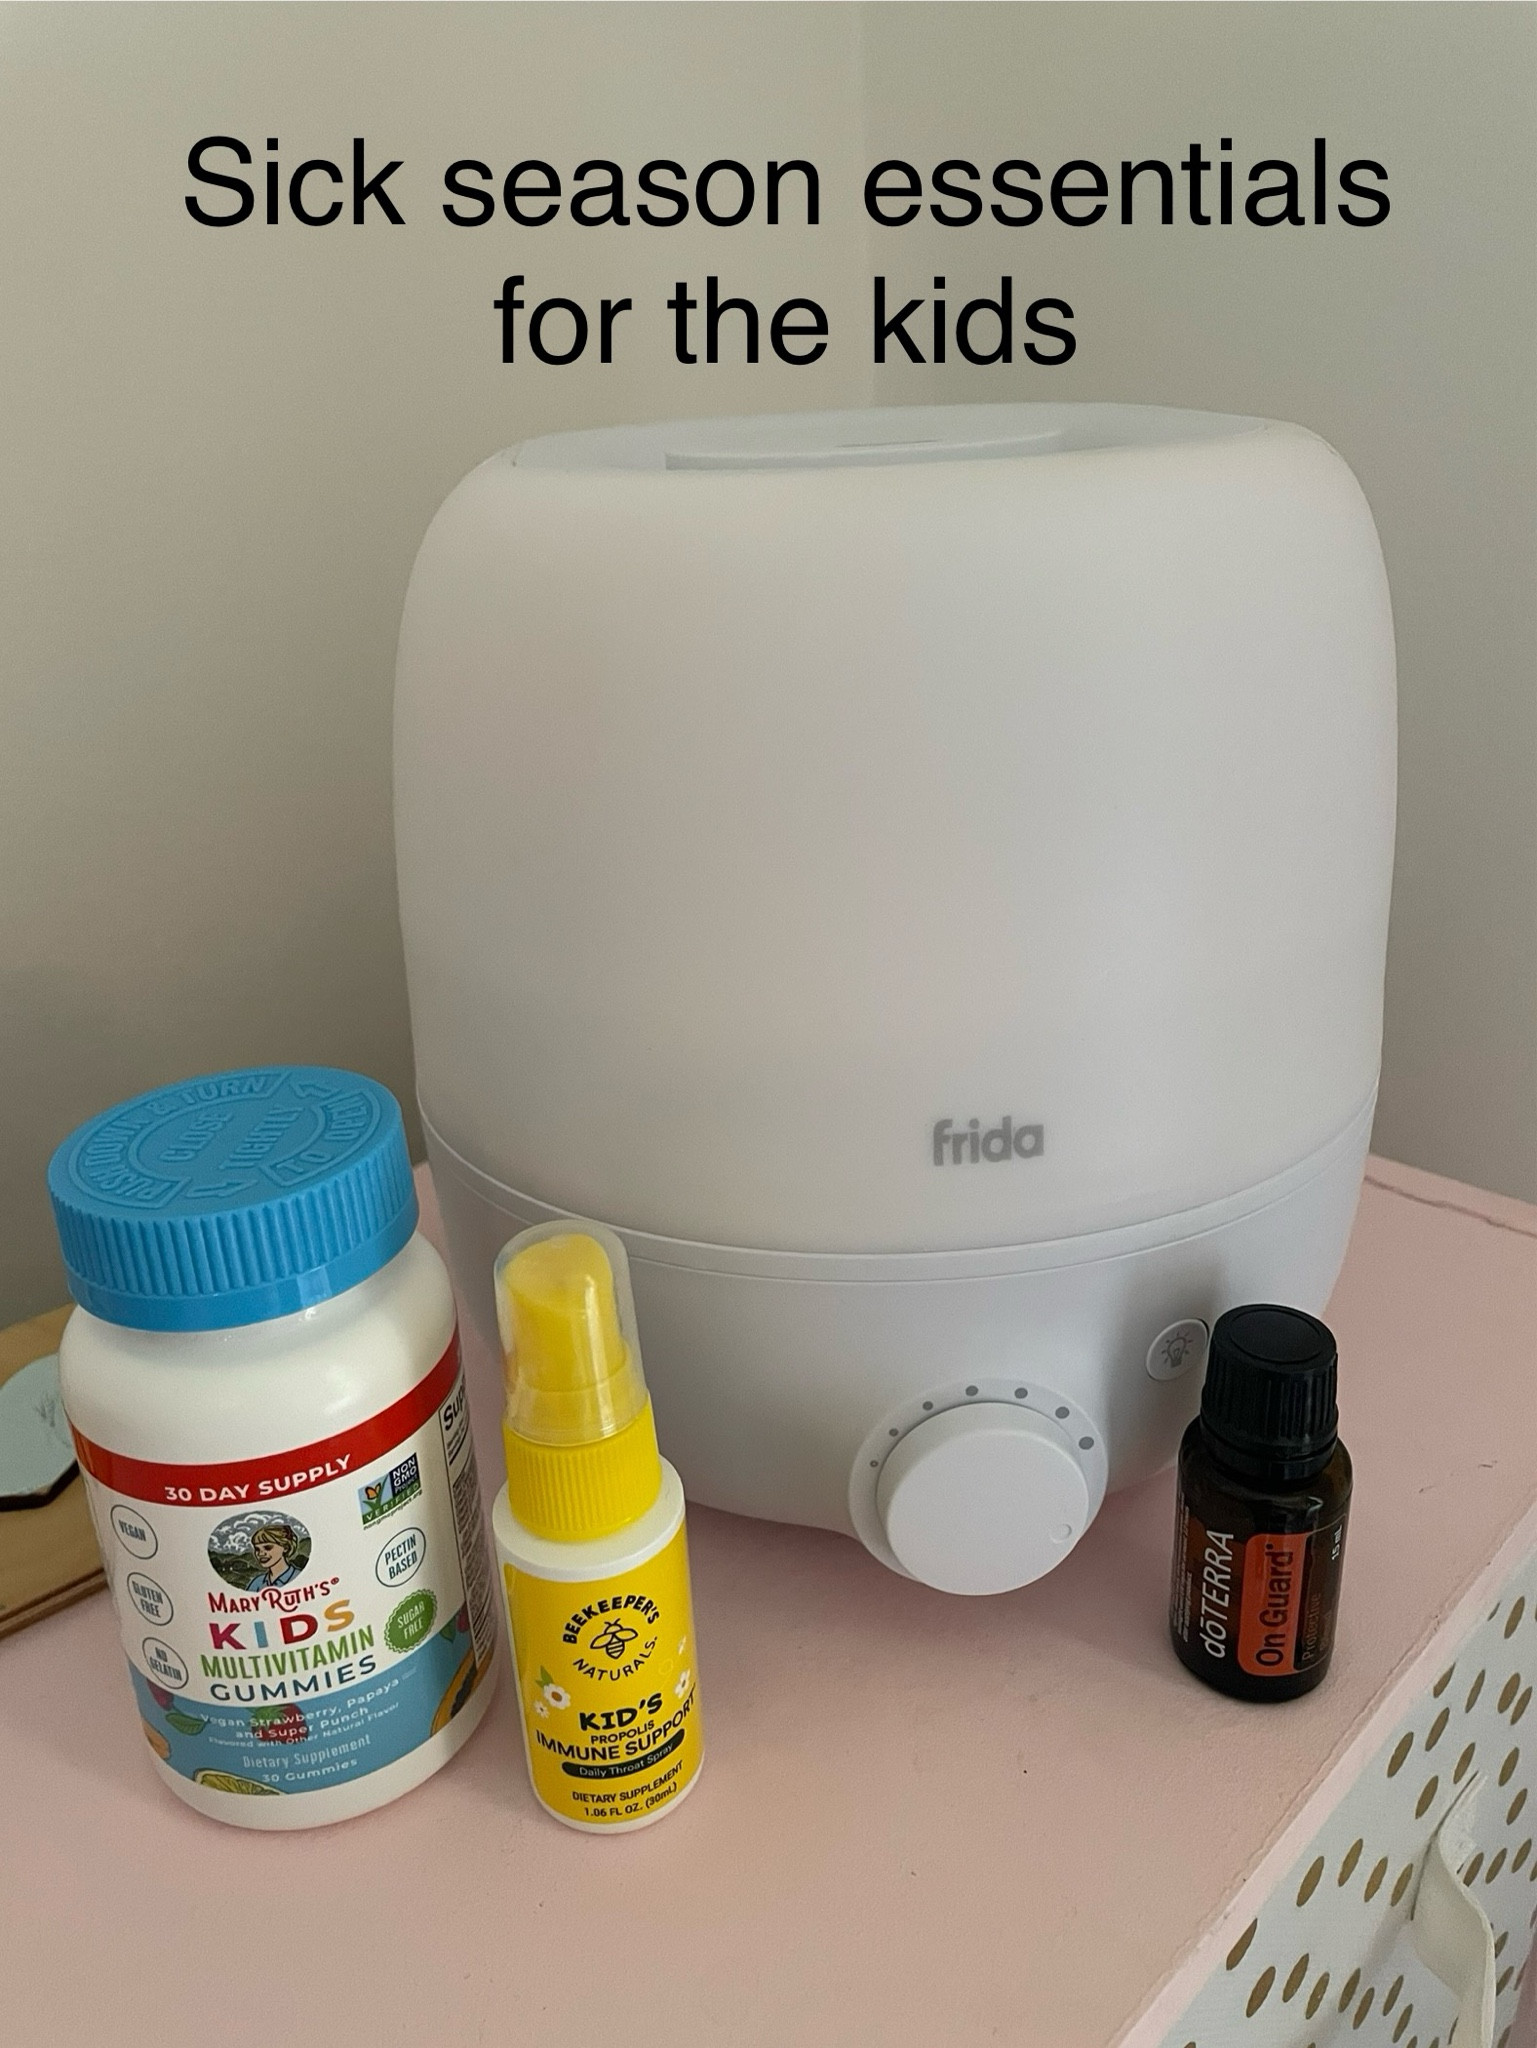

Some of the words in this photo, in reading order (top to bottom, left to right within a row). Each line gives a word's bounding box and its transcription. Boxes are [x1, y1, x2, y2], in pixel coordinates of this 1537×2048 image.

[181, 1076, 267, 1105] TURN
[933, 1114, 1045, 1167] frida
[164, 1486, 192, 1502] 30
[199, 1484, 250, 1502] DAY
[258, 1453, 351, 1495] SUPPLY
[392, 1456, 416, 1480] NON
[393, 1465, 417, 1487] GMO
[366, 1481, 420, 1521] VERIFIED
[118, 1519, 147, 1542] VEGAN
[384, 1533, 417, 1566] PECTIN
[388, 1550, 418, 1581] BASED
[131, 1580, 164, 1604] GLUTEN
[141, 1598, 162, 1619] FREE
[208, 1599, 356, 1650] KIDS
[397, 1601, 425, 1629] SUGAR
[562, 1594, 660, 1645] BEEKEEPER'S
[403, 1618, 424, 1640] FREE
[155, 1646, 169, 1663] NO
[201, 1624, 375, 1680] MULTIVITAMIN
[1255, 1633, 1286, 1667] On
[149, 1657, 183, 1681] GELATIN
[210, 1654, 377, 1701] GUMMIES
[200, 1713, 245, 1728] Vegan
[347, 1679, 399, 1708] Papaya
[579, 1692, 663, 1732] KID'S
[236, 1729, 263, 1739] and
[268, 1725, 314, 1737] Super
[320, 1707, 369, 1729] Punch
[323, 1719, 365, 1737] Natural
[536, 1730, 621, 1761] IMMUNE
[625, 1683, 696, 1756] SUPPORT
[591, 1720, 655, 1745] PROPOLIS
[243, 1755, 290, 1770] Dietary
[294, 1733, 372, 1767] Supplement
[579, 1766, 607, 1777] Daily
[608, 1760, 645, 1776] Throat
[646, 1743, 675, 1765] Spray
[262, 1773, 280, 1782] 30
[284, 1758, 358, 1781] Gummies
[572, 1790, 617, 1804] DIETARY
[619, 1760, 684, 1800] SUPPLEMENT
[584, 1807, 607, 1817] 1.06
[609, 1807, 623, 1817] FL
